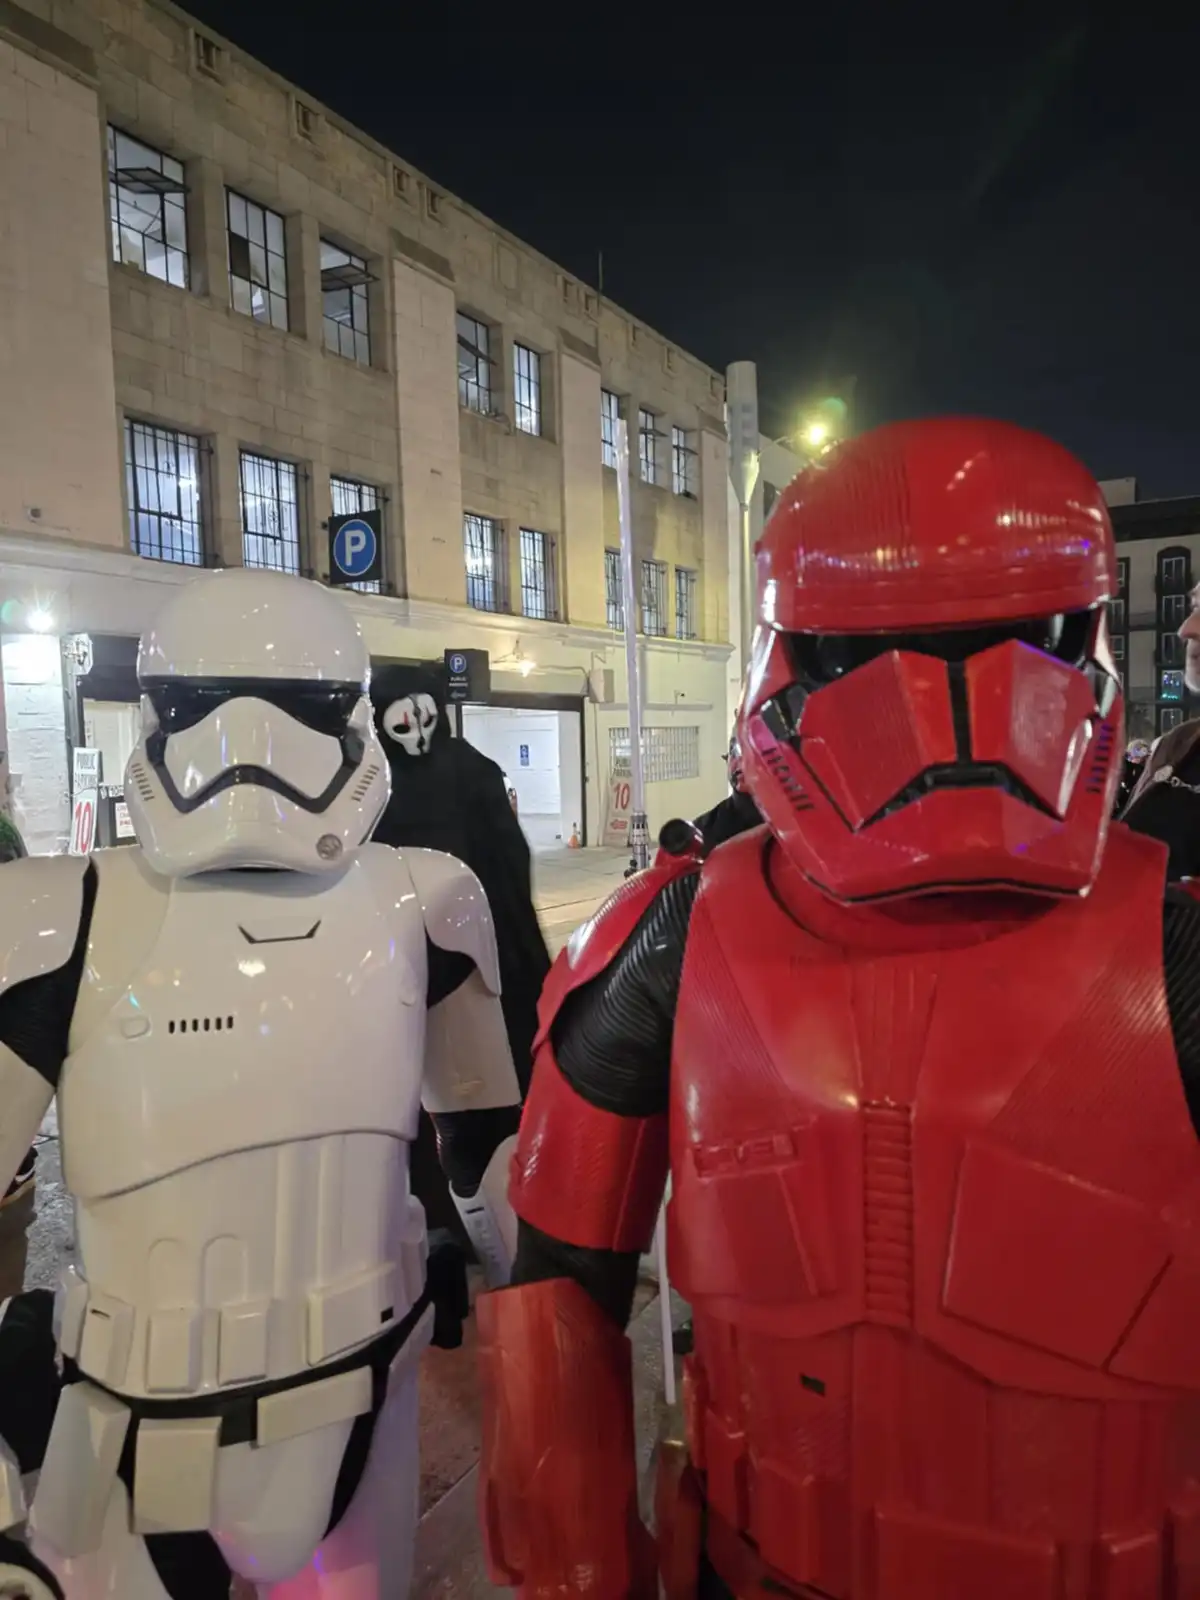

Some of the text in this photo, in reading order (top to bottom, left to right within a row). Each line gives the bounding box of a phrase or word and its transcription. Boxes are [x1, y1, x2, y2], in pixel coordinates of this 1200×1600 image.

[345, 530, 366, 566] P
[454, 656, 463, 669] P
[76, 752, 96, 770] PUBLIC
[614, 783, 630, 810] 10
[75, 801, 92, 854] 10
